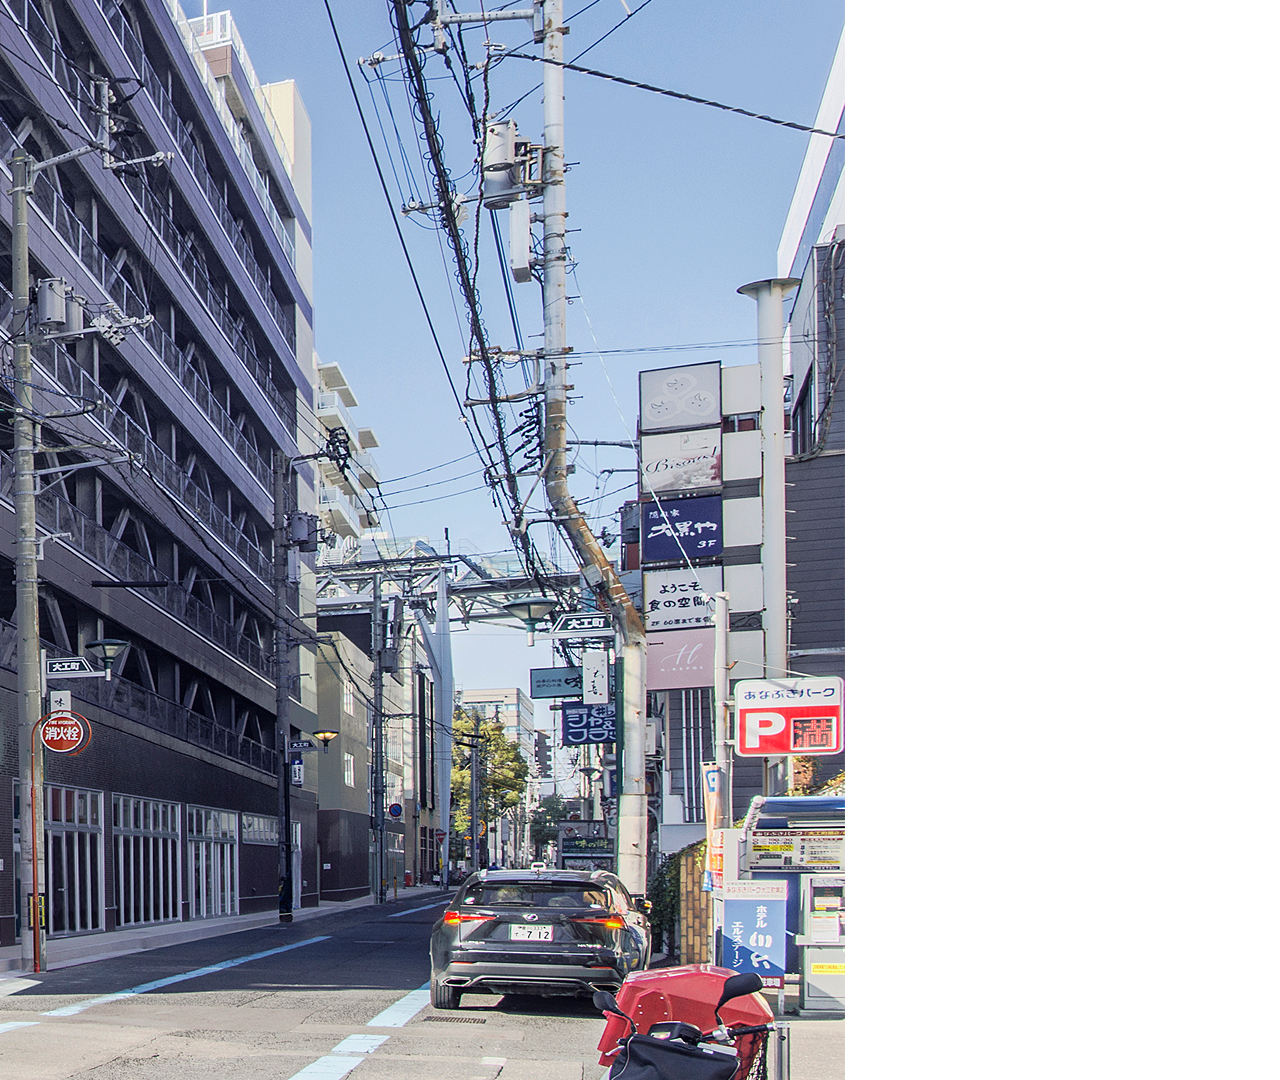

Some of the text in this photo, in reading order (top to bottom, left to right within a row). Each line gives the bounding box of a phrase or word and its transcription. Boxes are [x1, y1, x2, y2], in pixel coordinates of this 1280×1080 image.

[697, 539, 717, 548] 3F
[659, 581, 703, 594] ようこそ
[567, 618, 605, 629] 大工町
[52, 662, 80, 671] 大工町
[744, 688, 835, 700] あなぶきパーク
[45, 726, 79, 740] 消火栓
[746, 712, 786, 748] P
[794, 720, 833, 749] 満
[755, 905, 767, 928] ホテル
[731, 921, 744, 968] エルステージ
